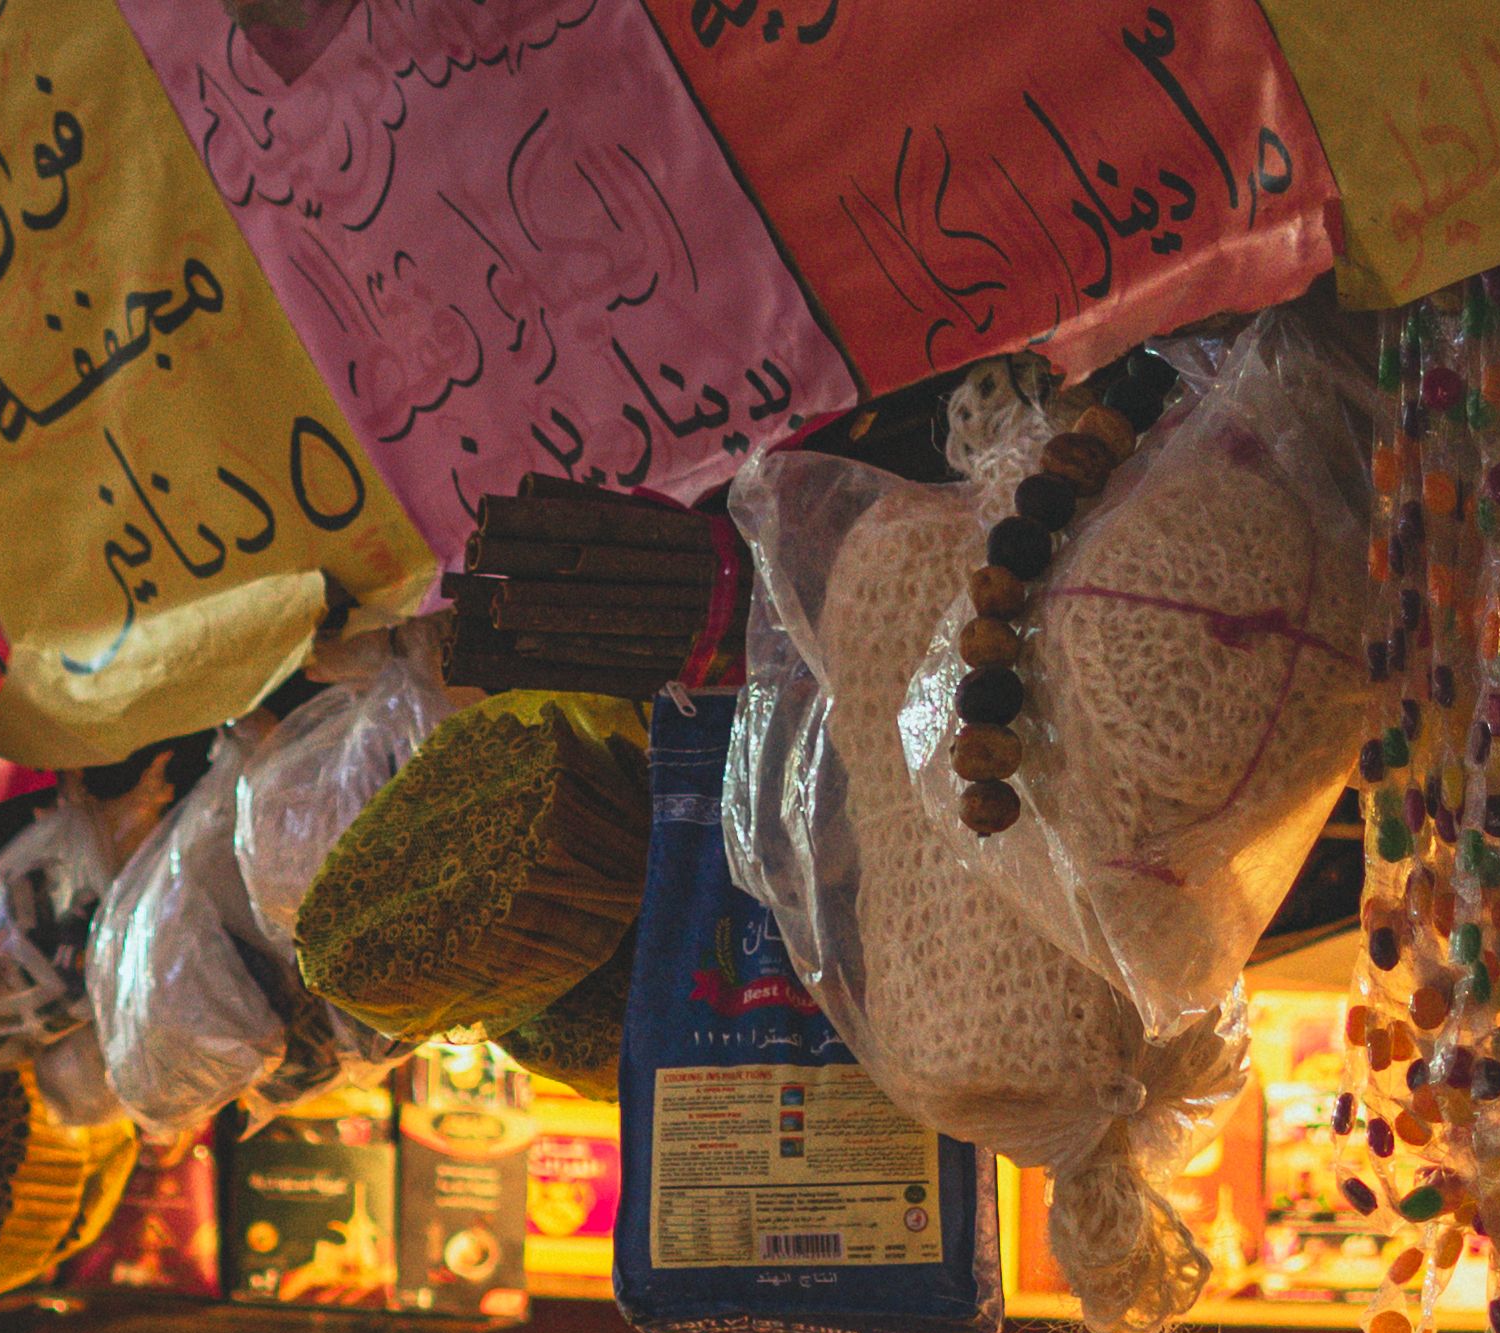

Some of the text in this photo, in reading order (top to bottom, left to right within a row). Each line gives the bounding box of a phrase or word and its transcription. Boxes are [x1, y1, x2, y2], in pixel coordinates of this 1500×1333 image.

[1024, 91, 1197, 296] دينار
[60, 427, 277, 674] دنانير
[289, 416, 366, 531] ٥
[743, 984, 779, 1004] Best
